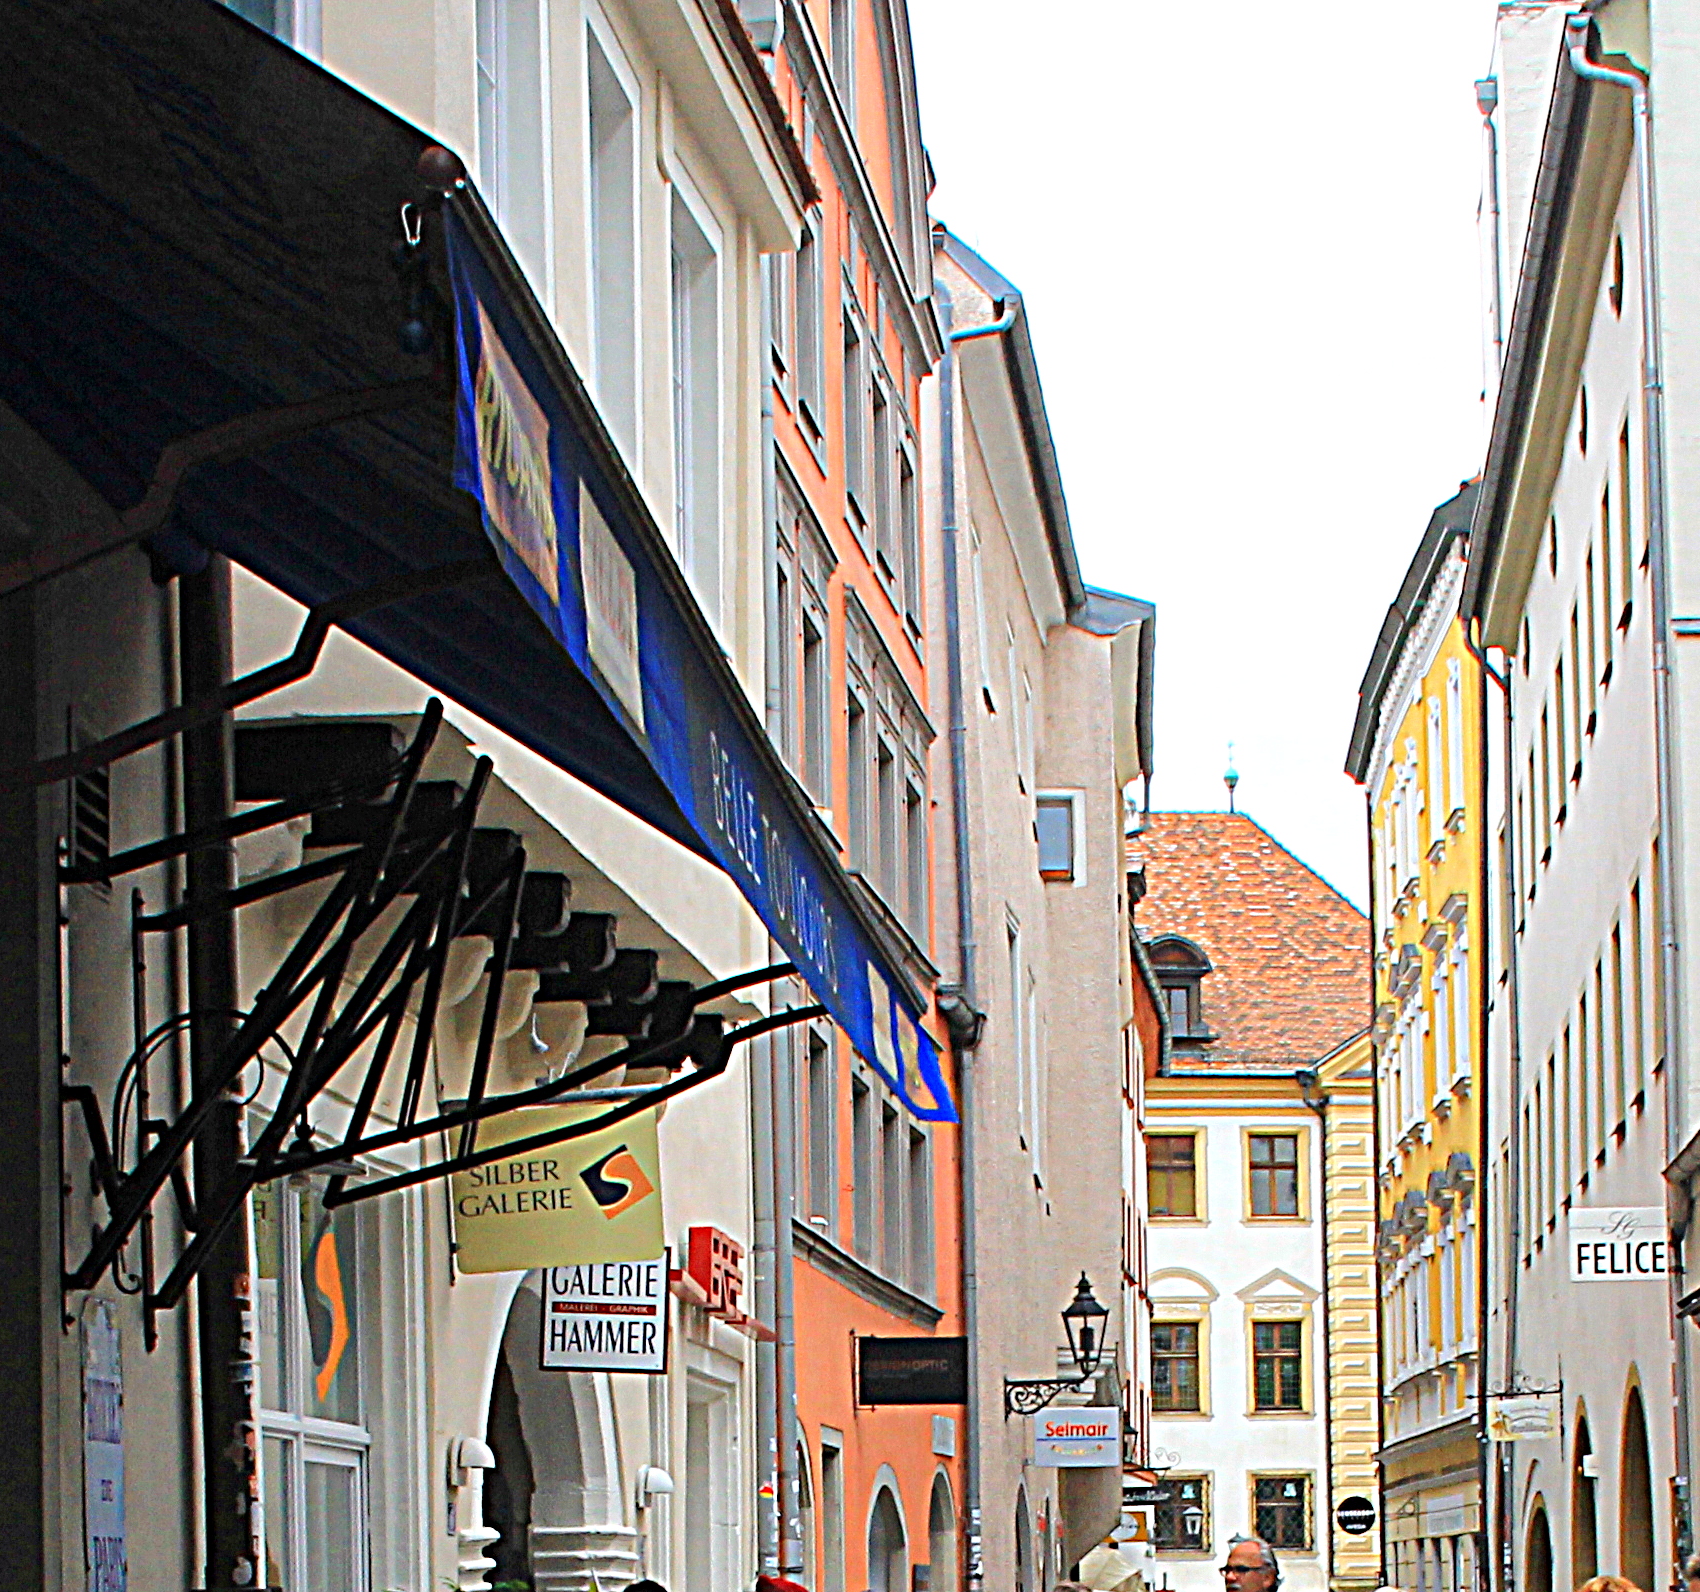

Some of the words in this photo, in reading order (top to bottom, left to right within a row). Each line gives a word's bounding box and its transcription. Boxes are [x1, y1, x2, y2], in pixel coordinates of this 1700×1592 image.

[709, 731, 762, 885] BELLE
[470, 1160, 560, 1188] SILBER
[458, 1188, 573, 1217] GALERIE
[1577, 1241, 1666, 1274] FELICE
[552, 1264, 658, 1297] GALERIE
[550, 1319, 656, 1354] HAMMER
[1045, 1421, 1109, 1437] Selmair
